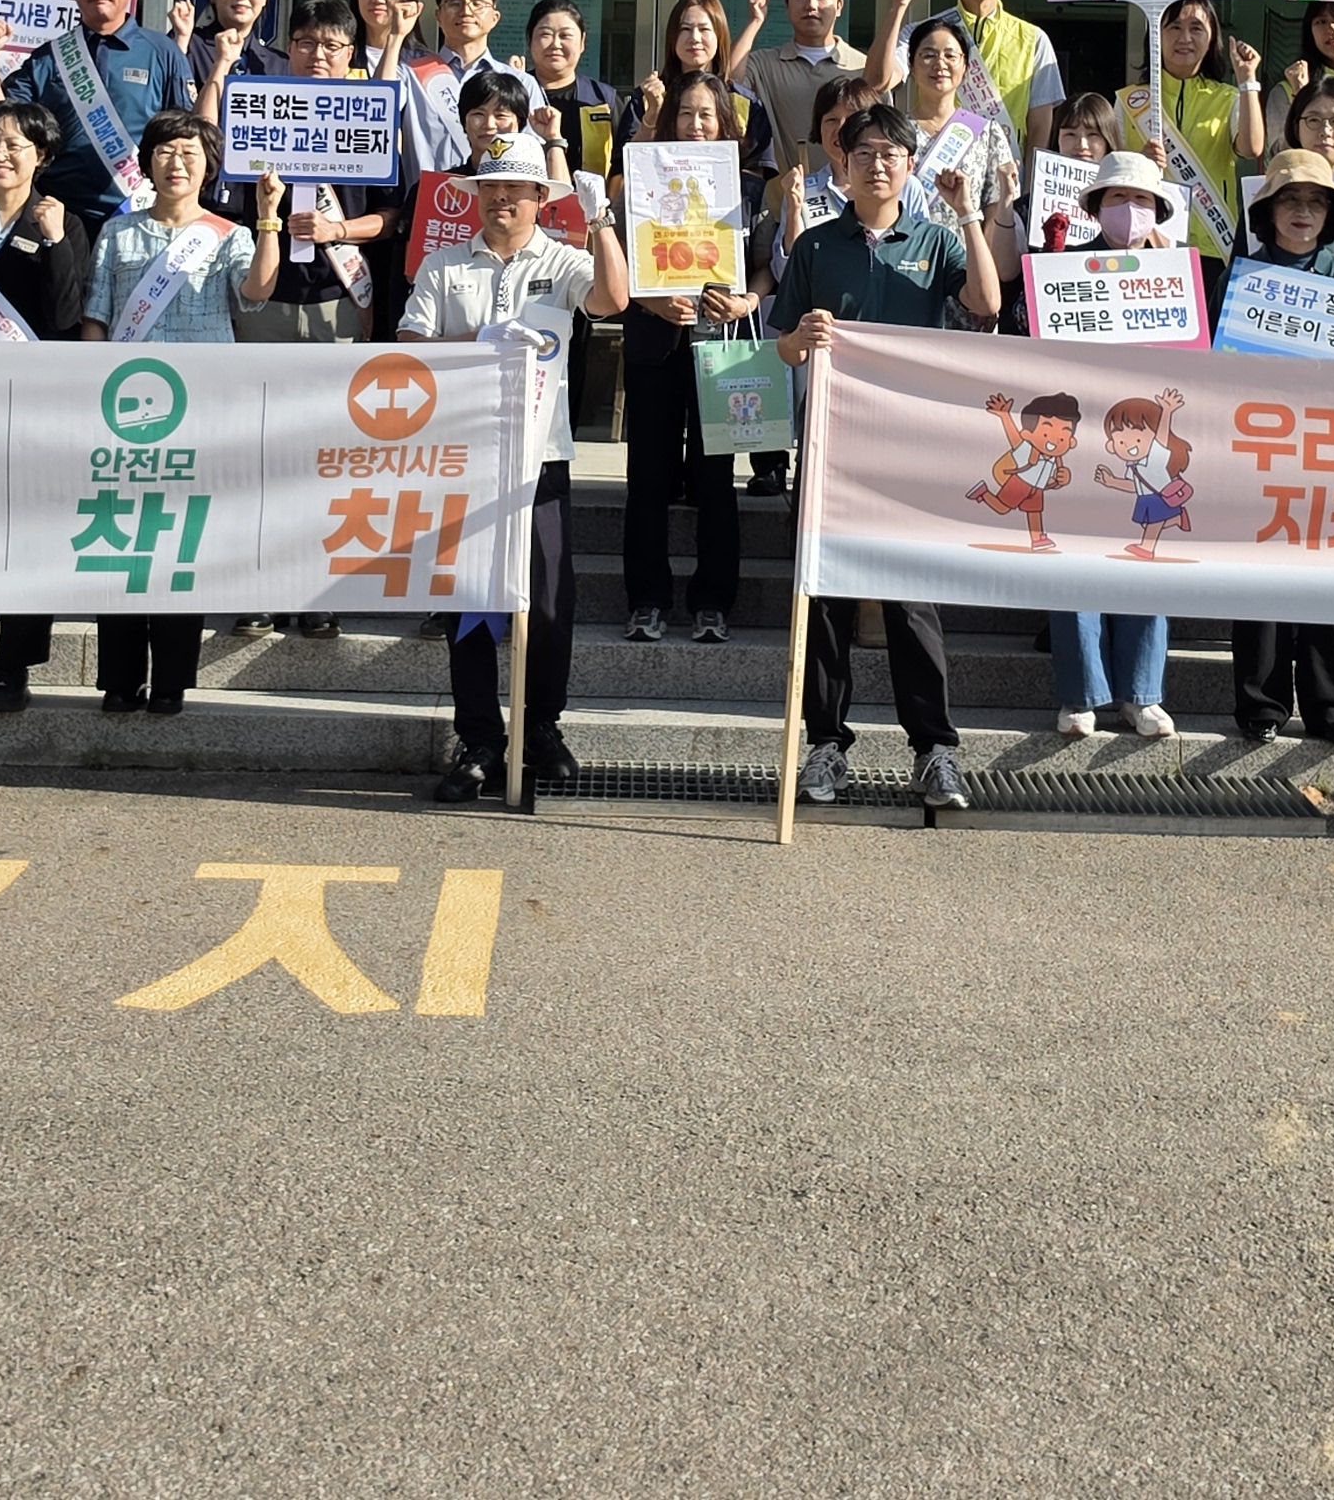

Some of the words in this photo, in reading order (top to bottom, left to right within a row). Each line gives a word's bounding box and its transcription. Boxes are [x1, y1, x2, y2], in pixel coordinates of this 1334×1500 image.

[230, 93, 267, 119] 폭력
[273, 94, 309, 120] 없는
[314, 96, 387, 122] 우리학교
[86, 104, 128, 160] 행복한
[231, 124, 288, 152] 행복한
[292, 127, 329, 153] 교실
[334, 128, 390, 155] 만들자
[652, 240, 720, 272] 109
[1044, 279, 1110, 303] 어른들은
[1118, 276, 1185, 301] 안전운전
[1243, 274, 1319, 311] 교통법규
[1048, 309, 1113, 334] 우리들은
[1122, 306, 1188, 331] 안전보행
[1245, 305, 1323, 343] 어른들이
[89, 445, 198, 484] 안전모
[316, 443, 469, 479] 방향지시등
[70, 489, 212, 594] 착!
[321, 488, 470, 598] 착!
